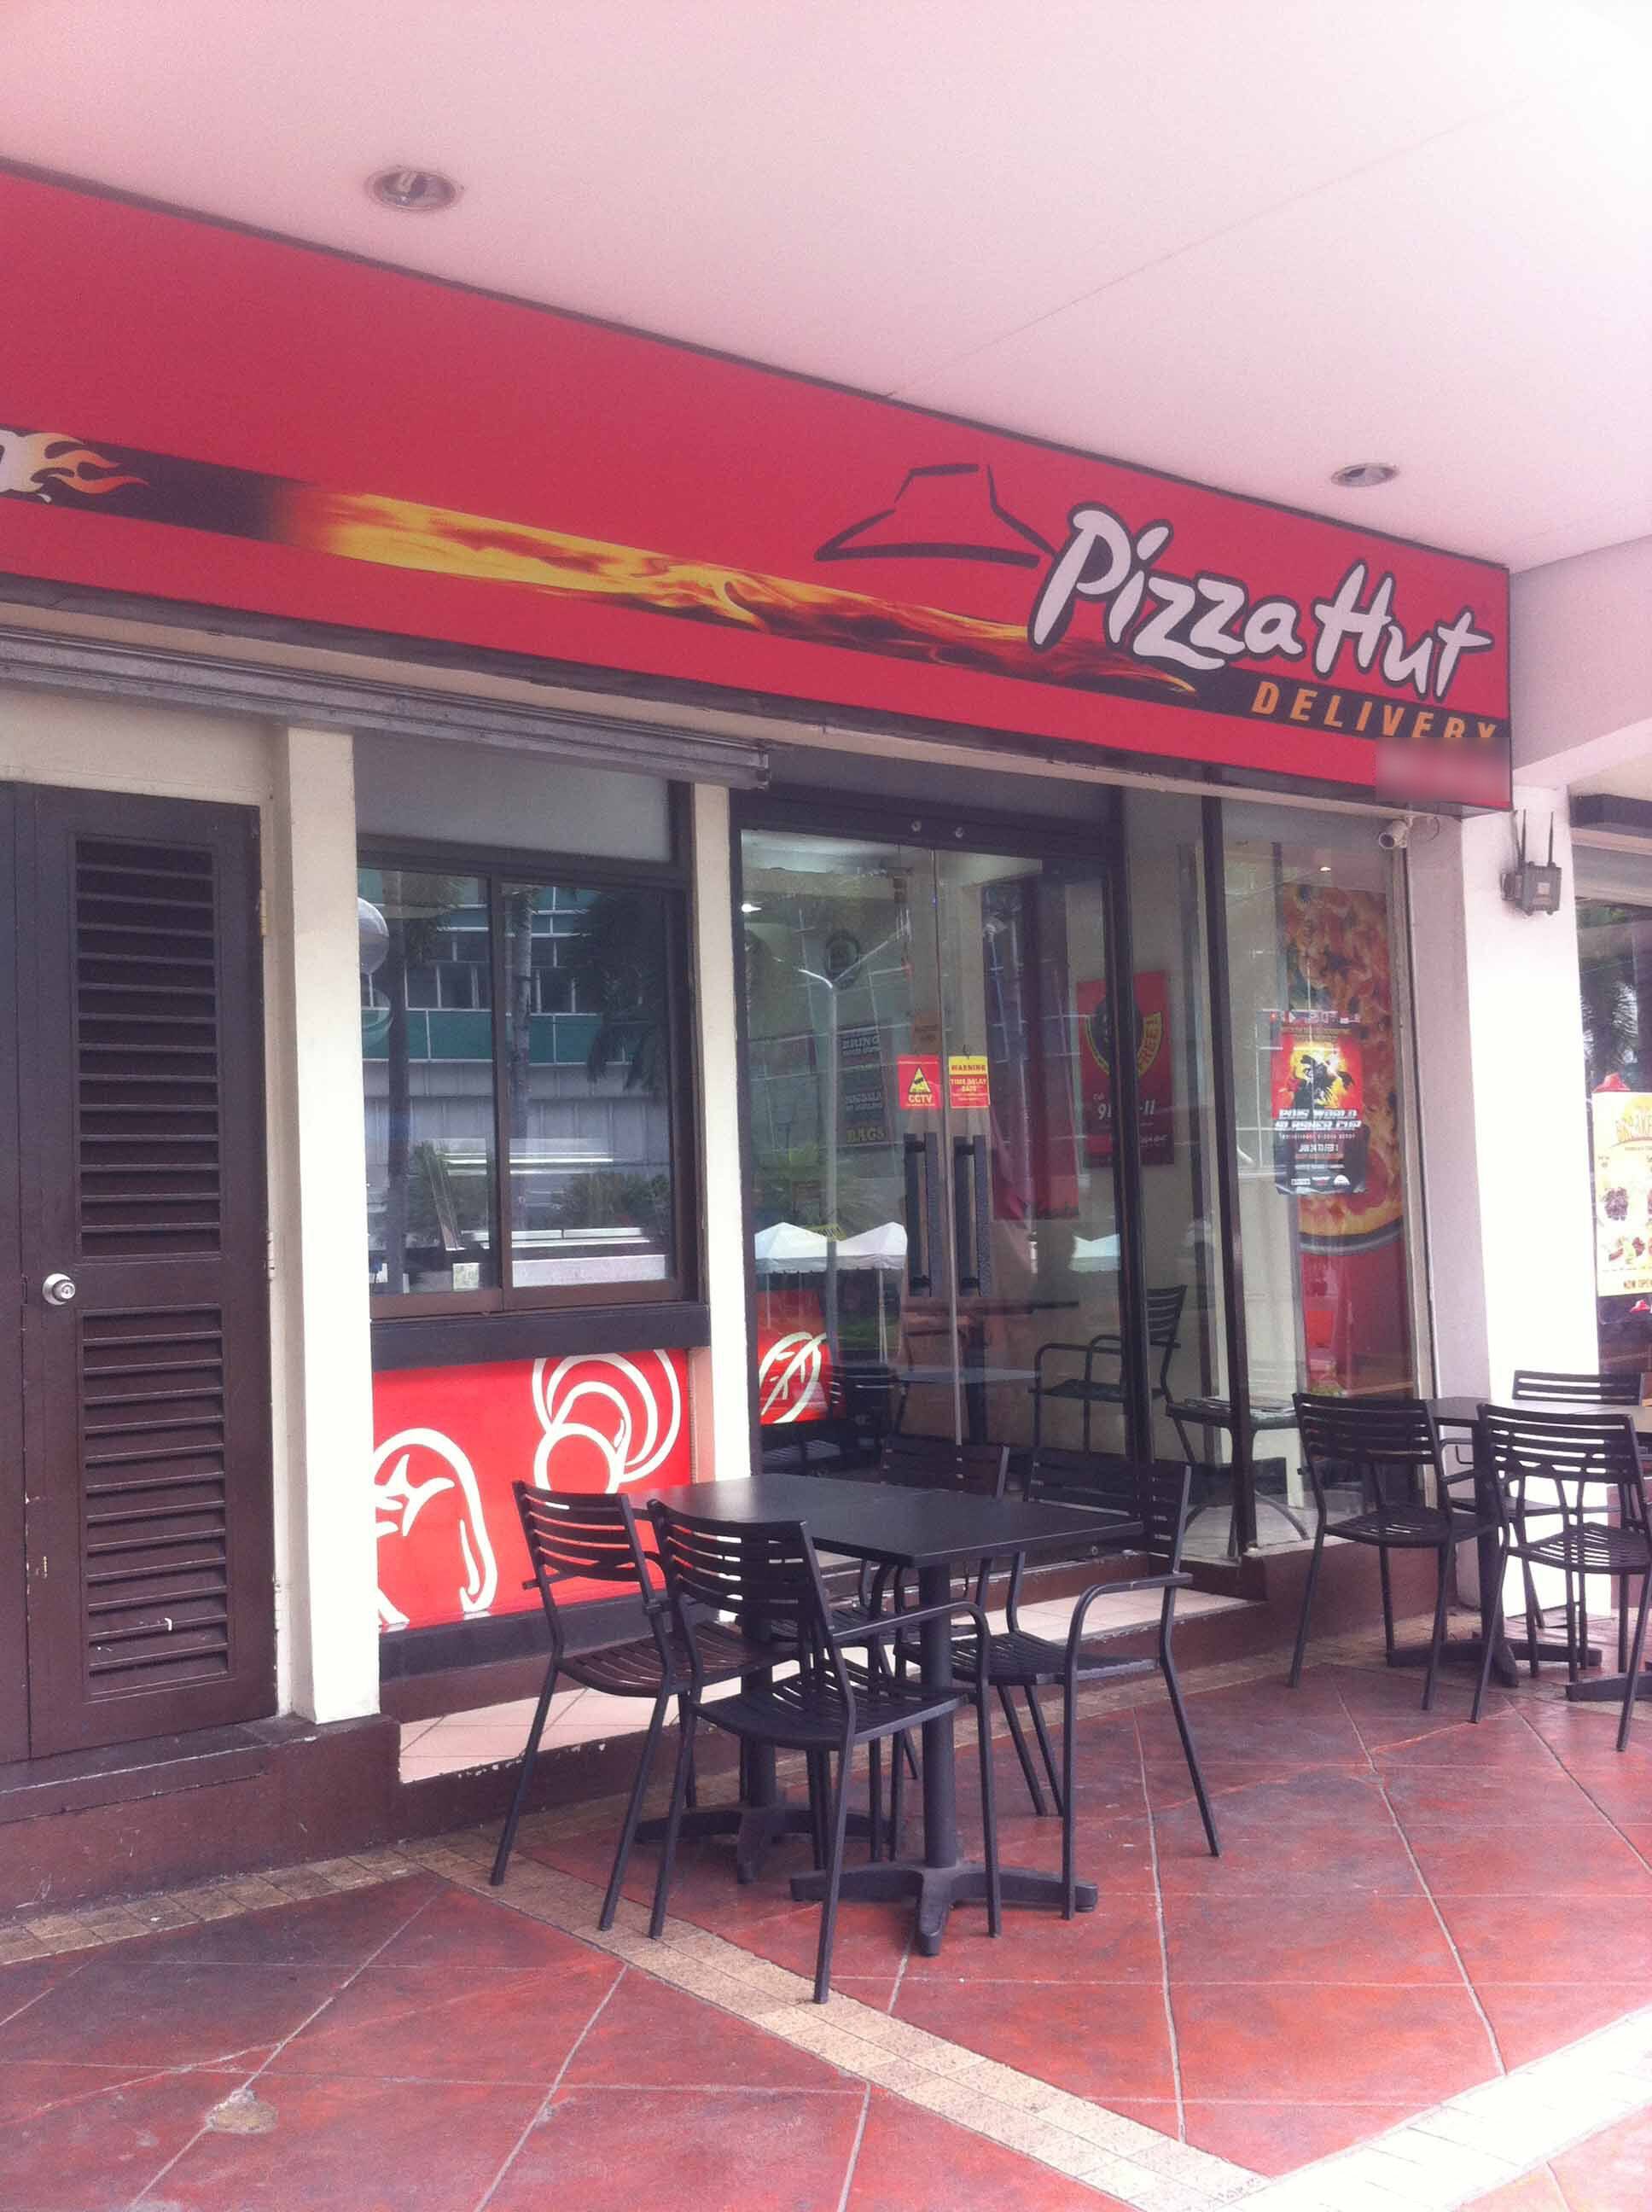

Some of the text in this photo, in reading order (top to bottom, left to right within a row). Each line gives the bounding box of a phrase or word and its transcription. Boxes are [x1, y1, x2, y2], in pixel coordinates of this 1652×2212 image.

[1032, 509, 1494, 698] Pizza Hut
[1250, 680, 1498, 739] DELIVERY
[908, 1093, 933, 1103] CCTV
